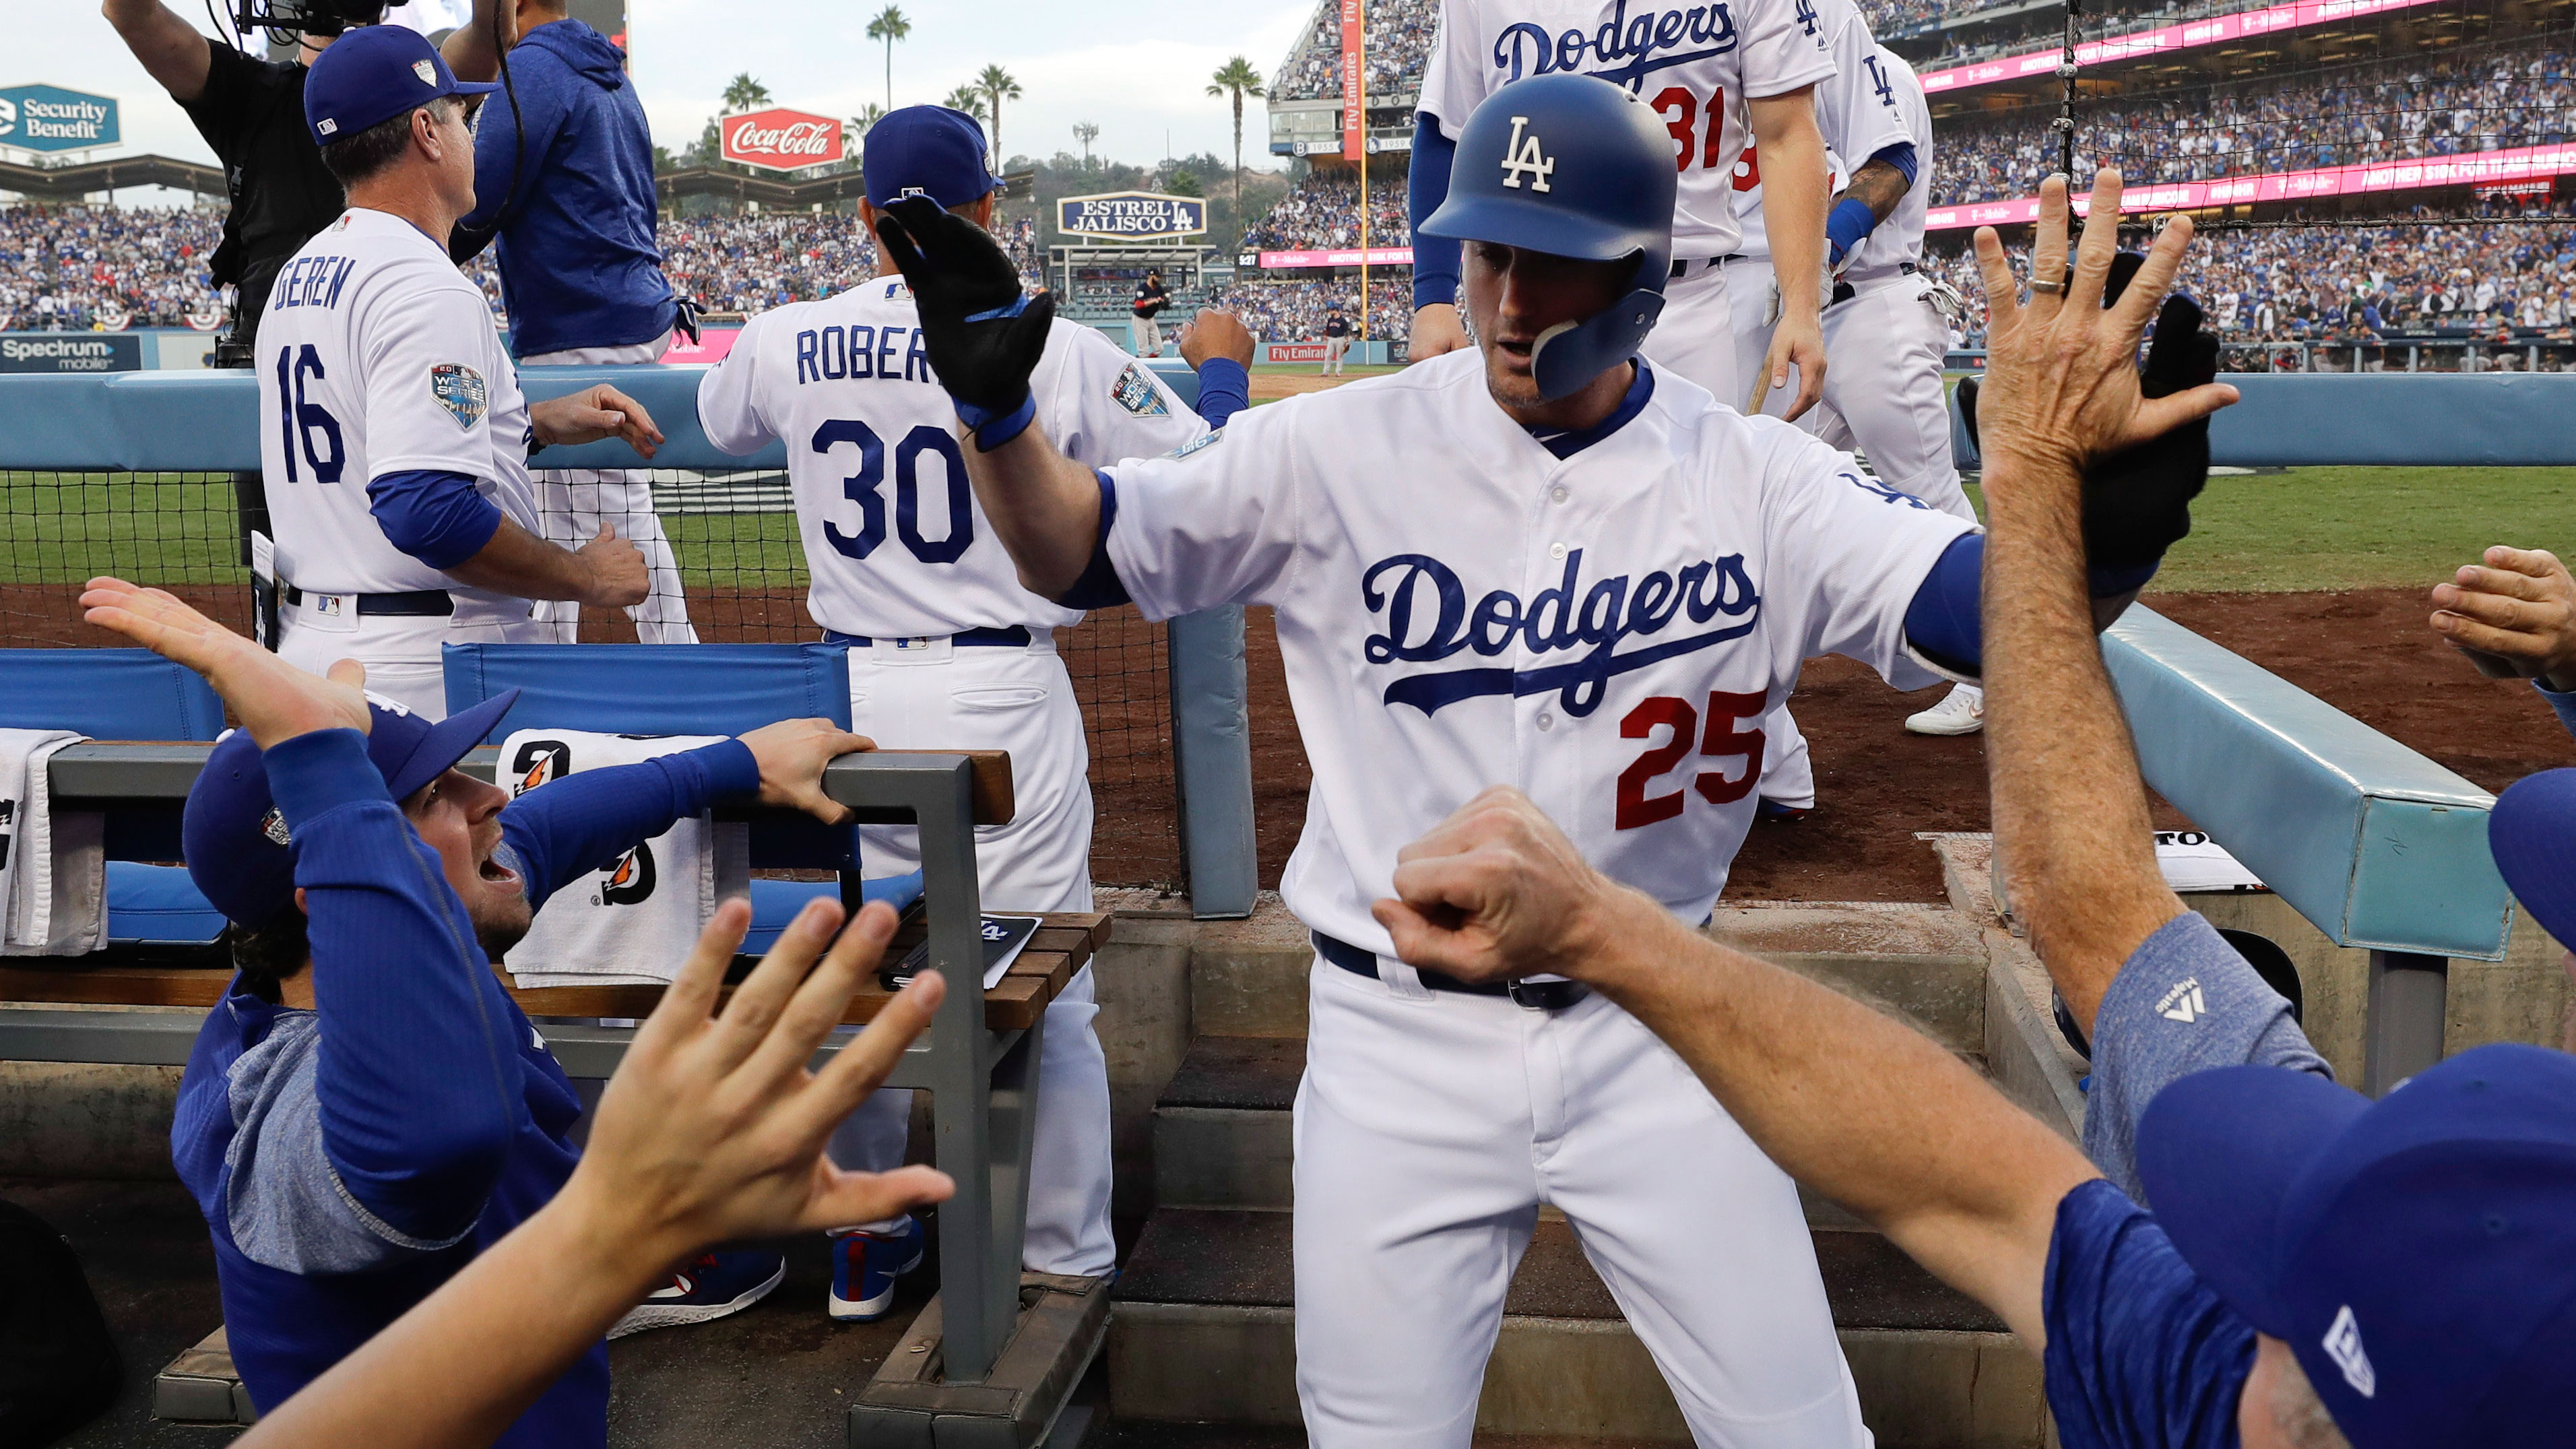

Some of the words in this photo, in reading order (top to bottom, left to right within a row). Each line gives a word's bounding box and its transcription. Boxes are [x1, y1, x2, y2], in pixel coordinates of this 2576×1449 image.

[1344, 1, 1358, 22] Fly
[1494, 0, 1739, 95] Dodgers
[1345, 52, 1357, 107] Emirates
[23, 98, 108, 124] Security
[1346, 108, 1359, 130] Fly
[26, 117, 99, 139] Benefit
[731, 121, 833, 154] Coca-Cola
[1650, 86, 1725, 172] 31
[1313, 142, 1334, 152] 1955
[1384, 140, 1406, 149] 1959
[1501, 116, 1555, 193] LA
[2362, 166, 2422, 187] ANOTHER
[2459, 160, 2488, 178] FOR
[1072, 216, 1167, 231] JALISCO
[1081, 201, 1171, 216] ESTREL
[1171, 201, 1193, 231] LA
[1239, 254, 1256, 266] 5:27
[1328, 253, 1363, 263] ANOTHE
[275, 256, 356, 311] GEREN
[2, 338, 107, 362] Spectrum
[59, 358, 108, 370] mobile
[797, 325, 943, 385] ROBER
[1273, 348, 1289, 360] Fly
[1120, 369, 1145, 403] WORLD
[277, 344, 346, 484] 16
[811, 419, 974, 565] 30
[1362, 548, 1761, 718] Dodgers
[1615, 688, 1768, 830] 25
[2154, 976, 2198, 1014] Majestic
